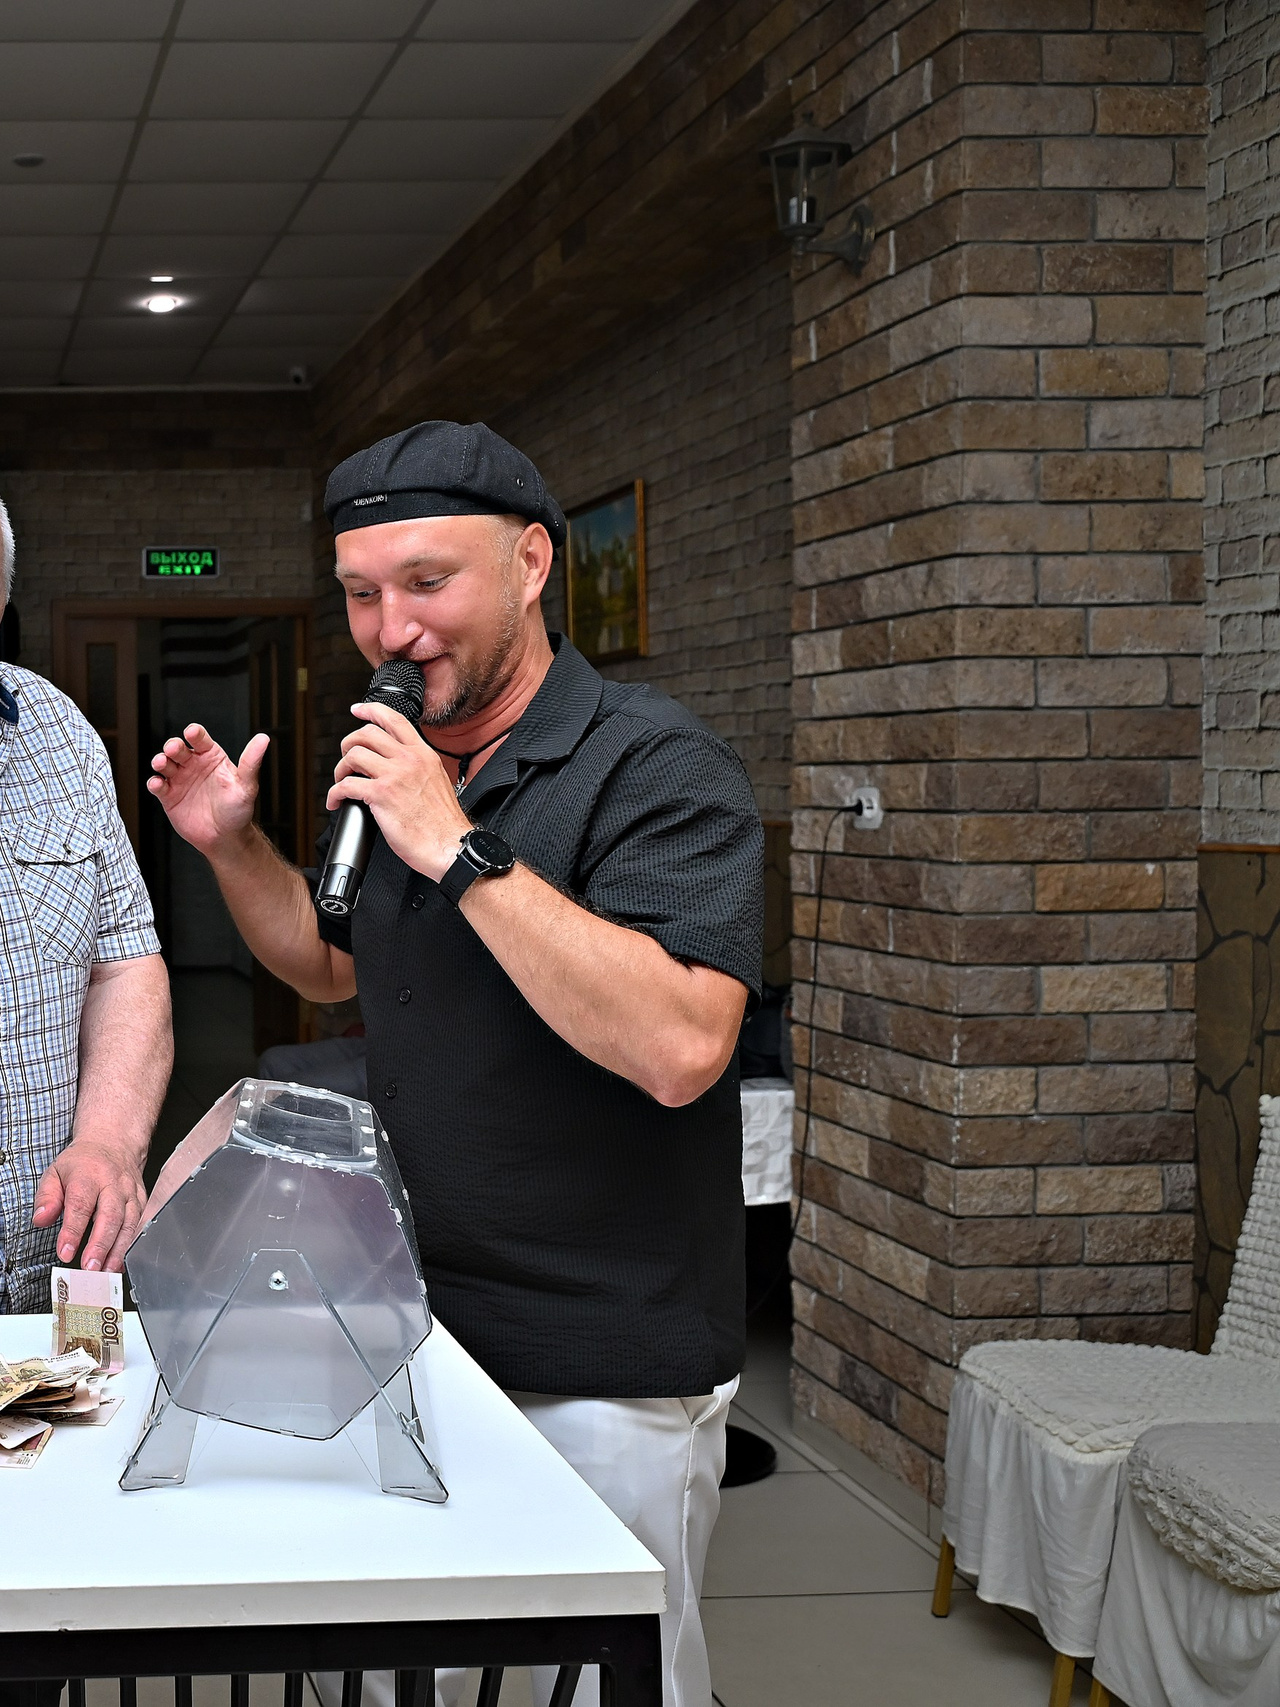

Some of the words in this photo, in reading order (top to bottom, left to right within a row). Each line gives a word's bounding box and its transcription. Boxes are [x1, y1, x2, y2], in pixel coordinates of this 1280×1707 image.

[150, 551, 213, 567] ВЫХОД
[158, 565, 204, 575] EXIT
[101, 1306, 119, 1346] 100
